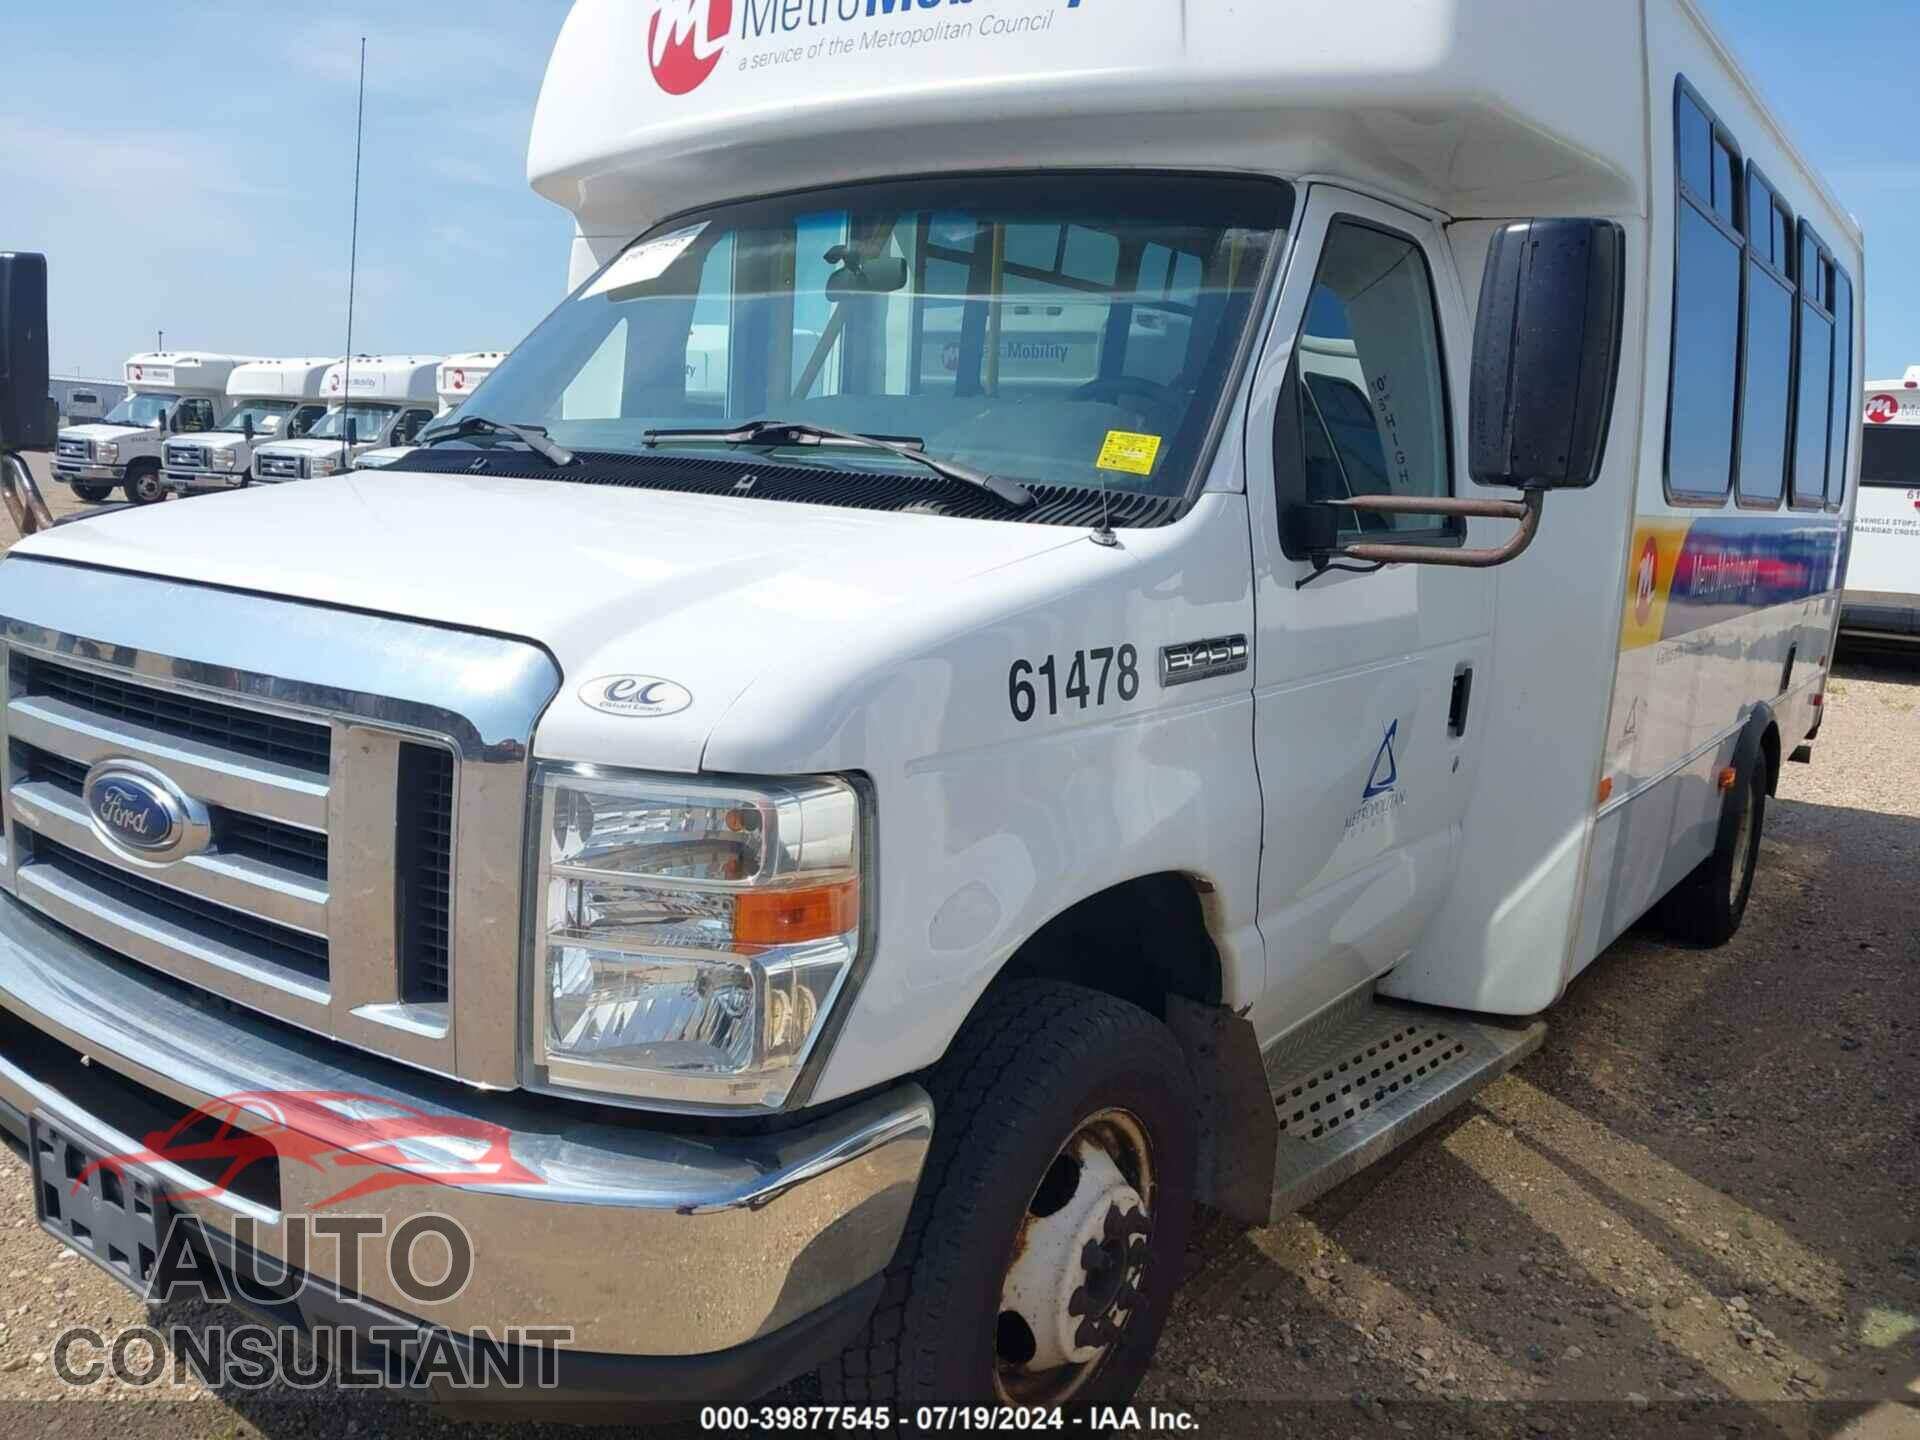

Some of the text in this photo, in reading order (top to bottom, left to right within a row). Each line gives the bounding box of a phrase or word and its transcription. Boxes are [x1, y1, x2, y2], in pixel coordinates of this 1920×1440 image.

[738, 9, 1055, 71] a service of the Metropolitan Council
[1002, 341, 1069, 363] Mobility
[1008, 643, 1140, 722] 61478
[100, 786, 149, 835] Ford
